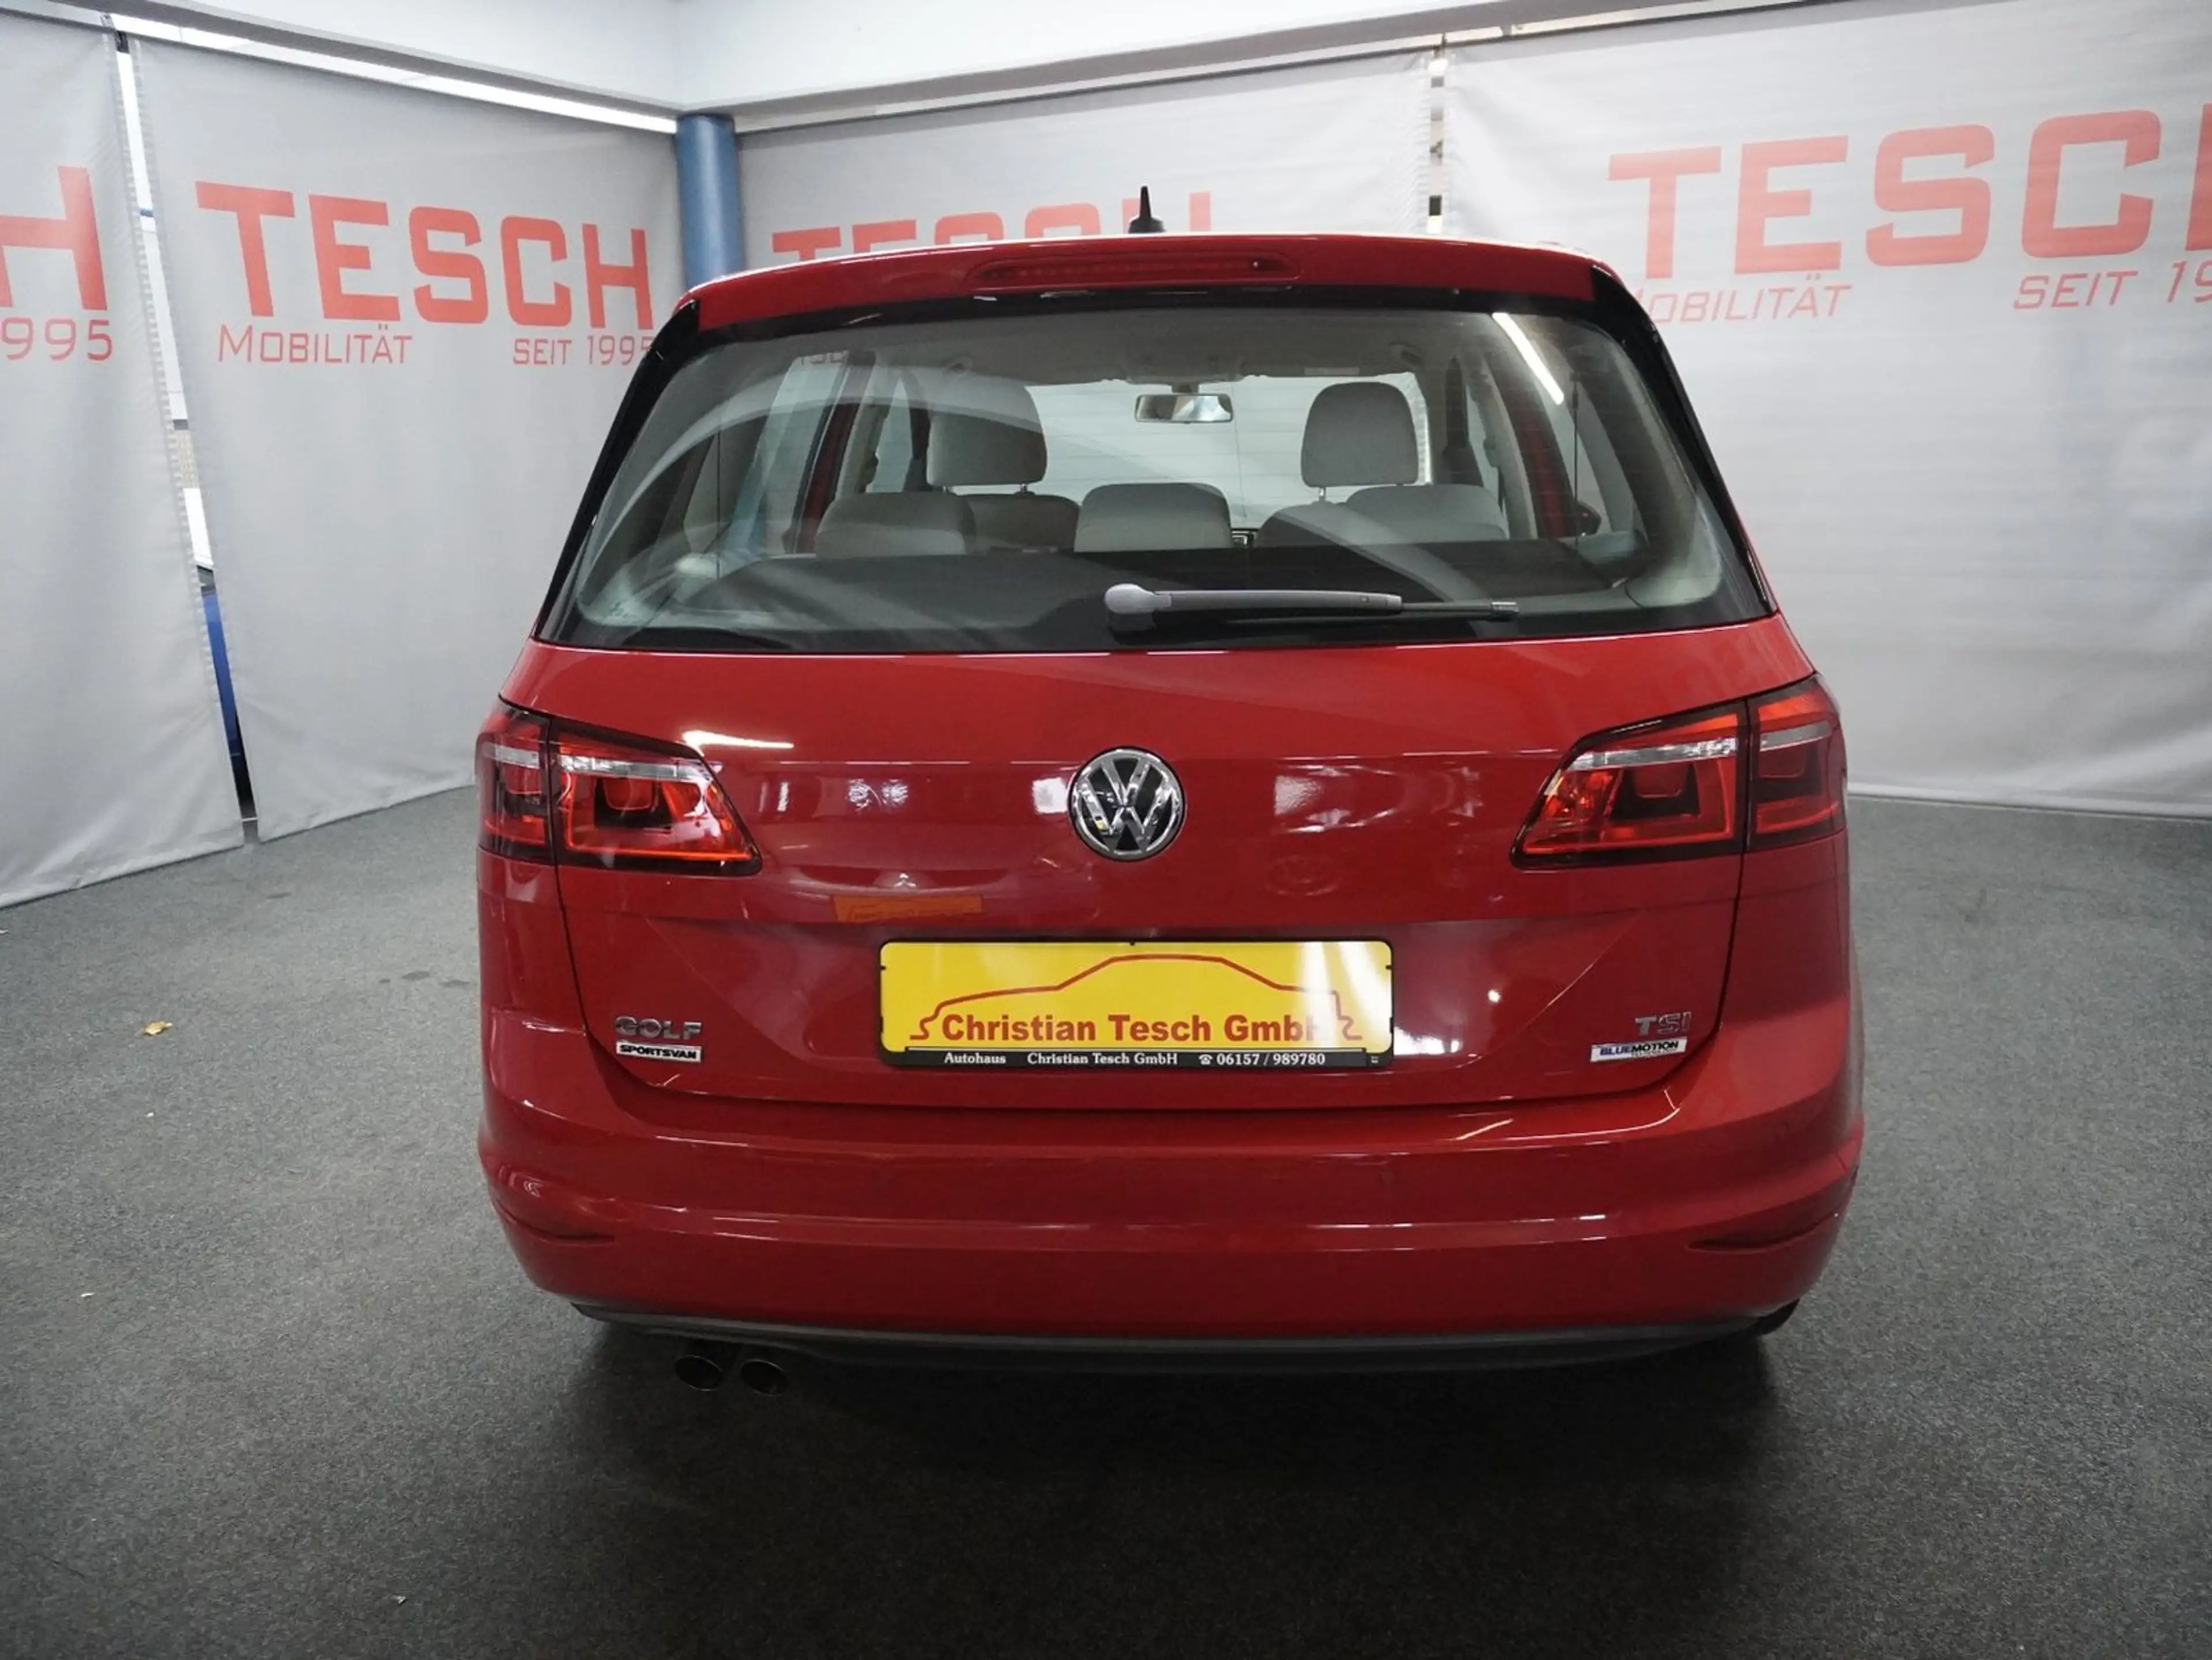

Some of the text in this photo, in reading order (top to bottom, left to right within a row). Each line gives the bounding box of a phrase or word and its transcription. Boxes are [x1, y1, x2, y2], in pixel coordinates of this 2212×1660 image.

[195, 181, 654, 330] TESCH
[1633, 274, 1852, 325] OBILITÄT
[2013, 271, 2139, 309] SEIT
[513, 338, 572, 365] SEIT
[615, 1016, 702, 1040] GOLF
[942, 1014, 1096, 1042] Christian
[1108, 1014, 1211, 1042] Tesch
[1635, 1011, 1692, 1036] TSI
[619, 1044, 697, 1059] SPORTSVAN
[944, 1052, 1007, 1065] Autohaus
[1027, 1052, 1088, 1065] Christian
[1092, 1052, 1131, 1065] Tesch
[1134, 1053, 1178, 1065] GmbH
[1216, 1054, 1260, 1066] 06157
[1272, 1053, 1325, 1065] 989780
